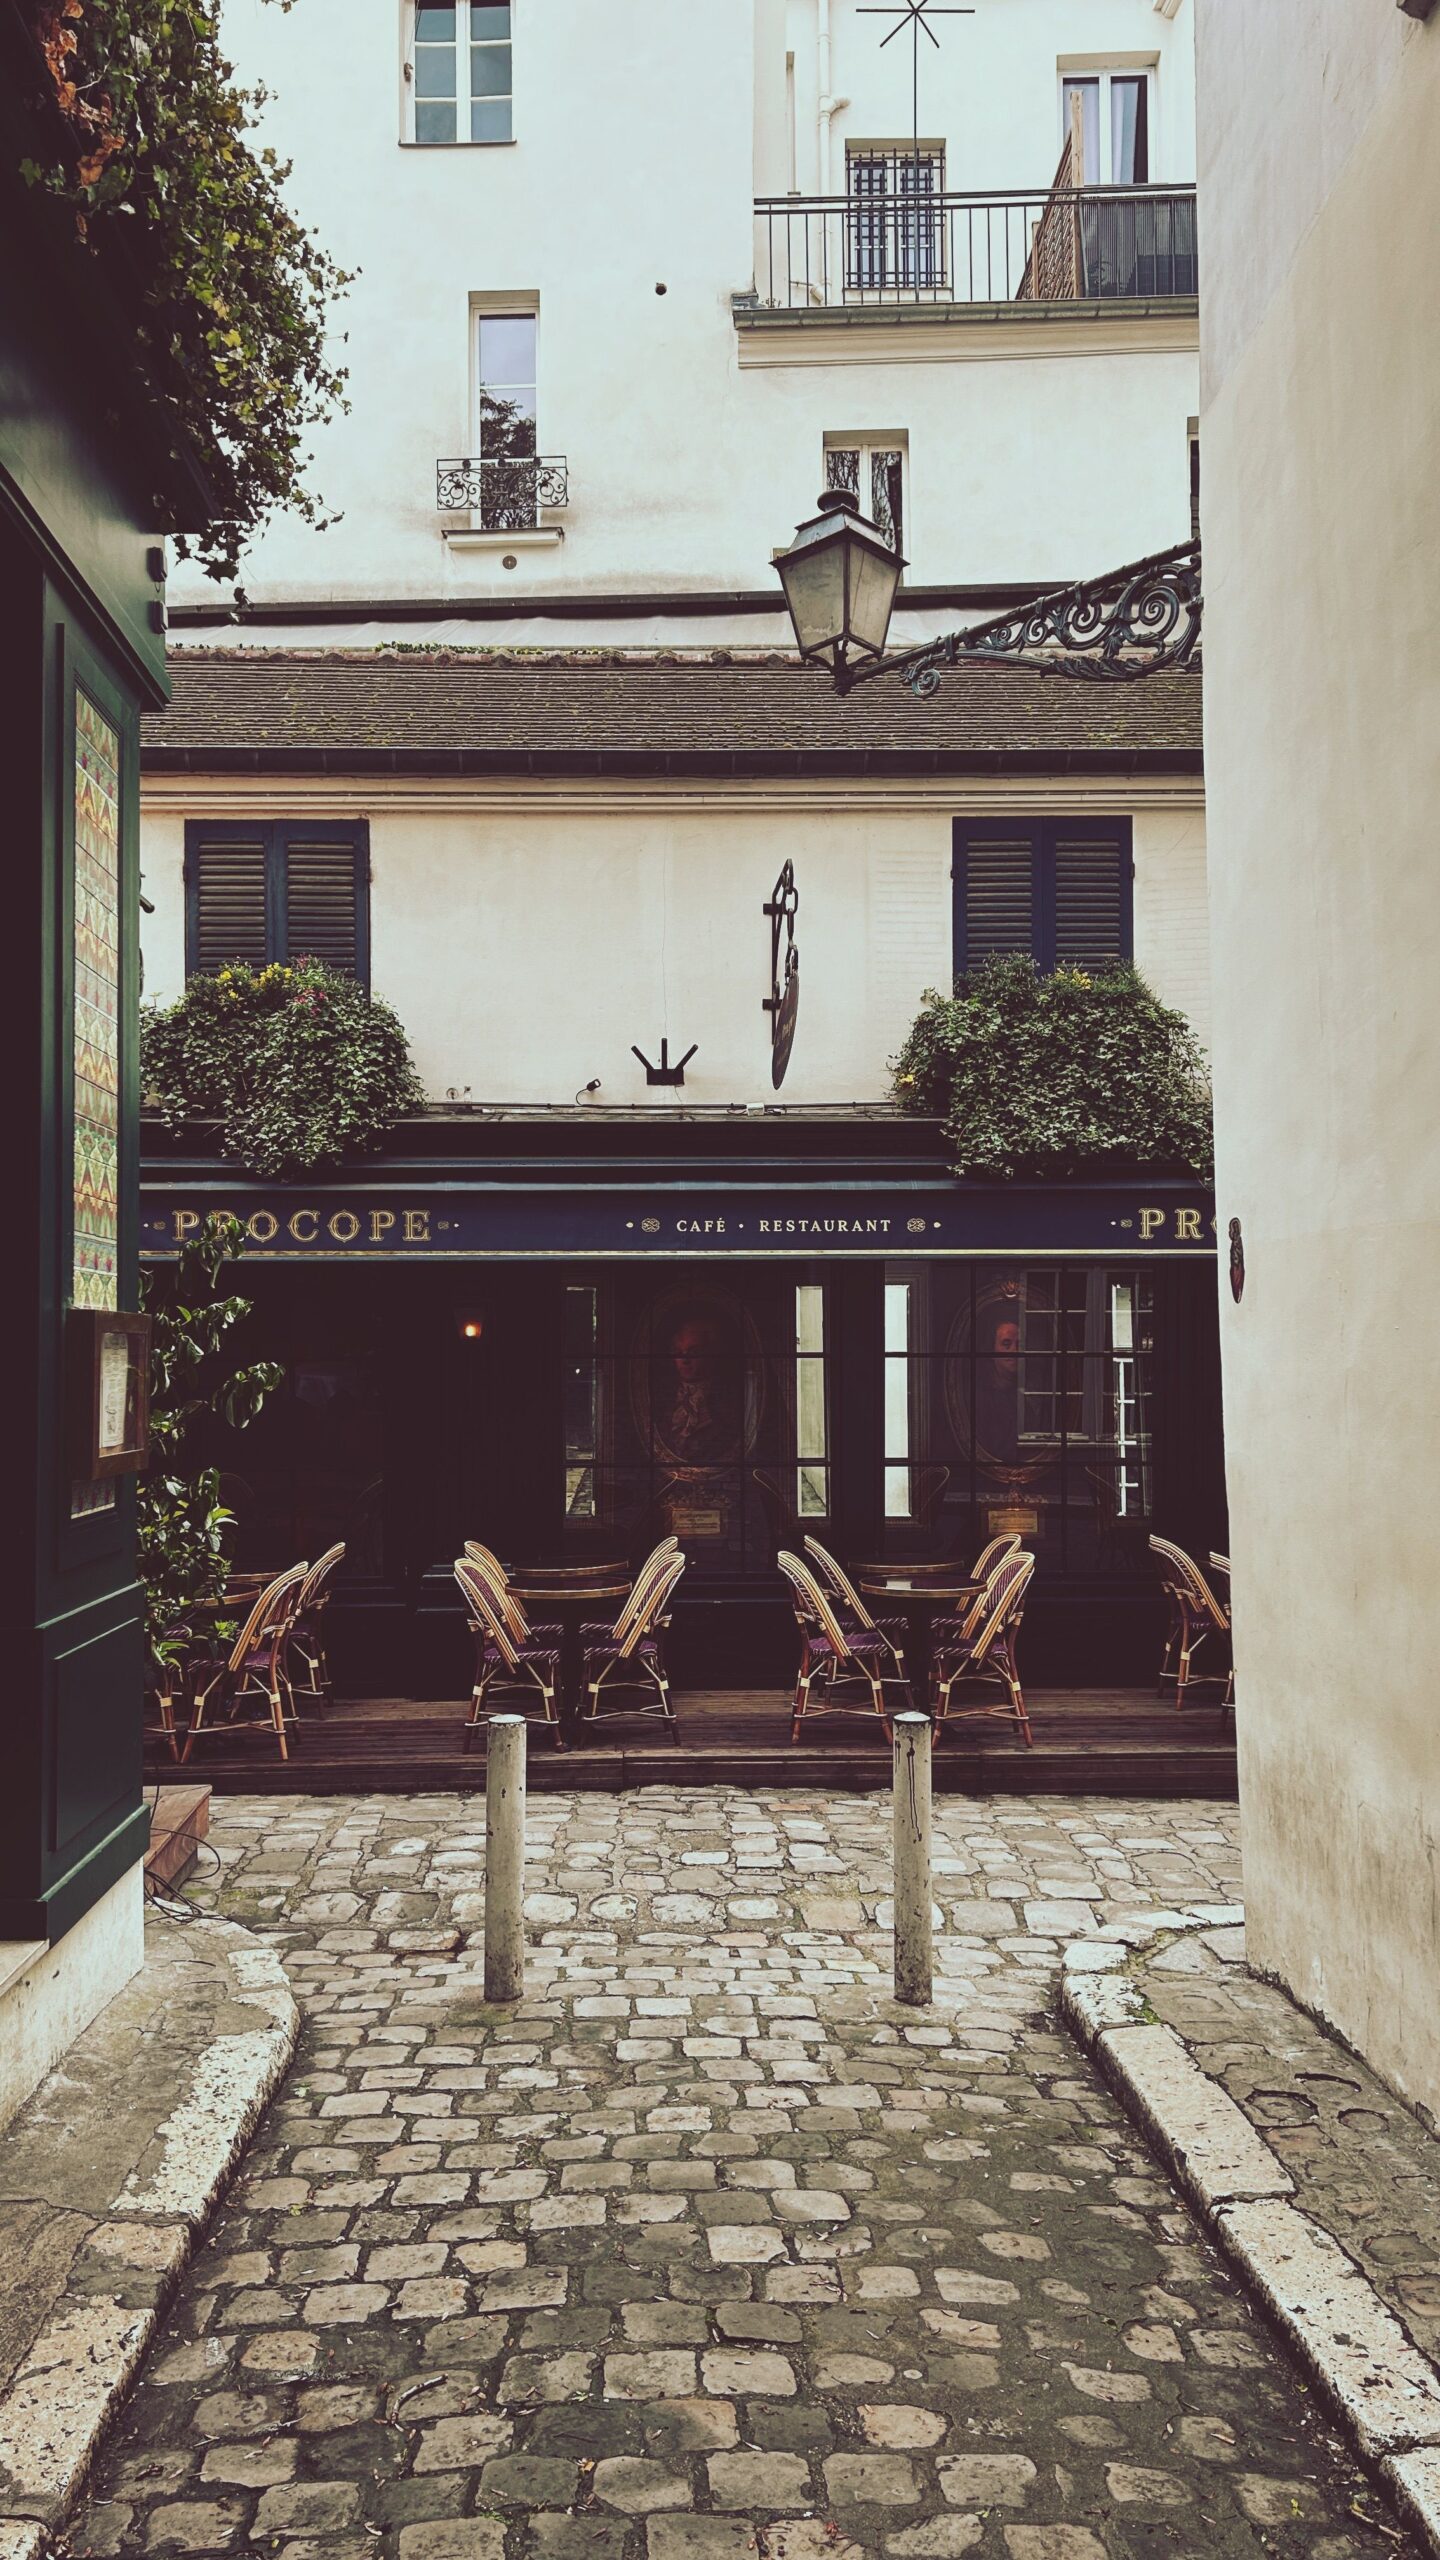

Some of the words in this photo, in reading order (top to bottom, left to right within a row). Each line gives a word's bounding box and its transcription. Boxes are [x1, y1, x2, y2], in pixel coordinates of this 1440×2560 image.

[676, 1217, 726, 1233] CAFÉ
[759, 1219, 891, 1233] RESTAURANT
[1138, 1208, 1217, 1240] PR
